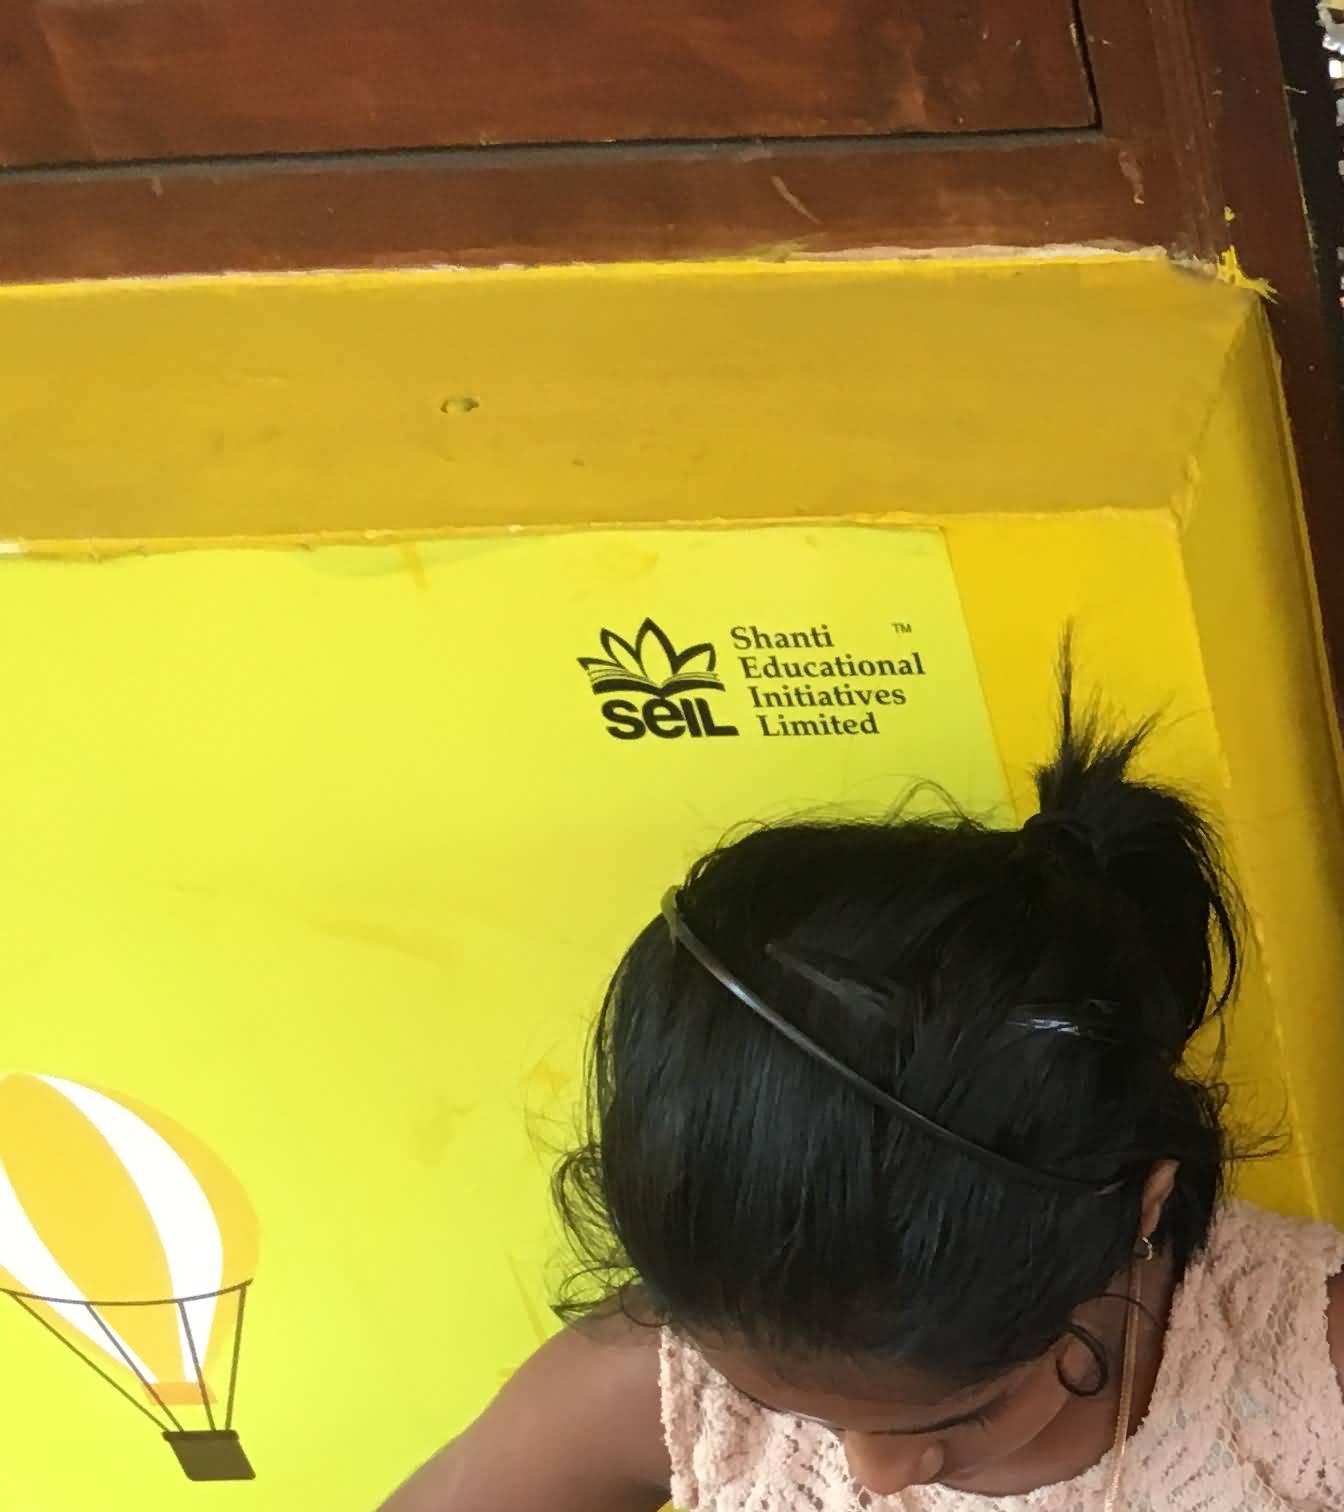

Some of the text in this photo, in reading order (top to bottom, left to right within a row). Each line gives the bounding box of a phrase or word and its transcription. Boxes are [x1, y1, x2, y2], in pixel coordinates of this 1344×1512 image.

[730, 624, 835, 650] Shanti
[739, 652, 926, 680] Educational
[747, 684, 907, 708] Initiatives
[756, 712, 881, 737] Limited
